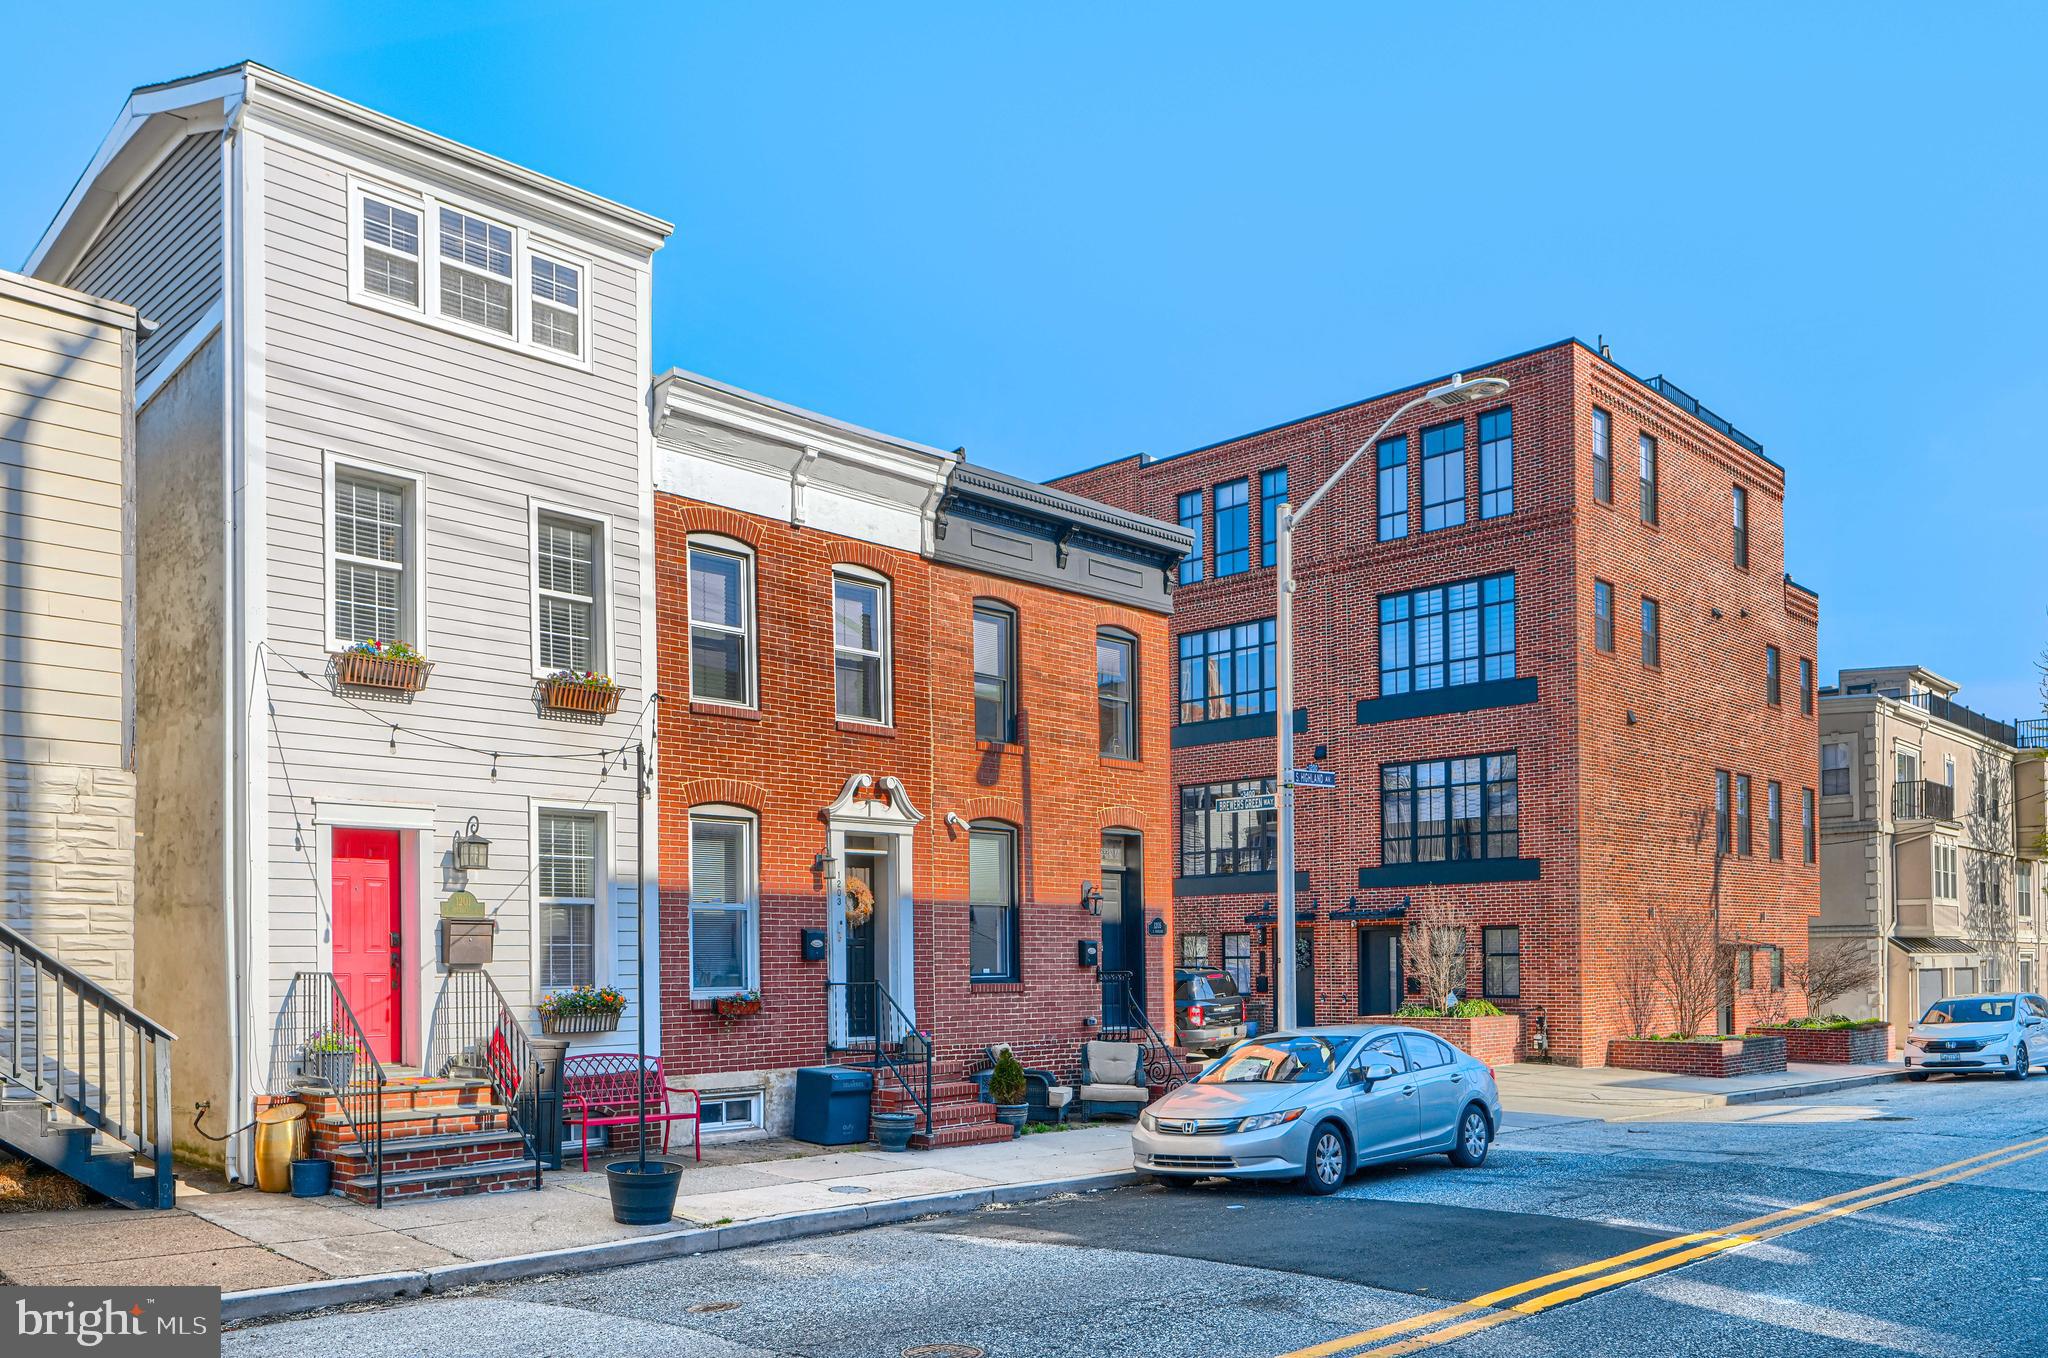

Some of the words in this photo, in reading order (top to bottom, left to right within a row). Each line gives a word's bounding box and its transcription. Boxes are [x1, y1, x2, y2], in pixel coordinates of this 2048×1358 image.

[1300, 772, 1324, 784] HIGHLAND
[1219, 799, 1244, 811] BREWERS
[1244, 797, 1263, 809] GREEN
[1263, 798, 1274, 806] WAY
